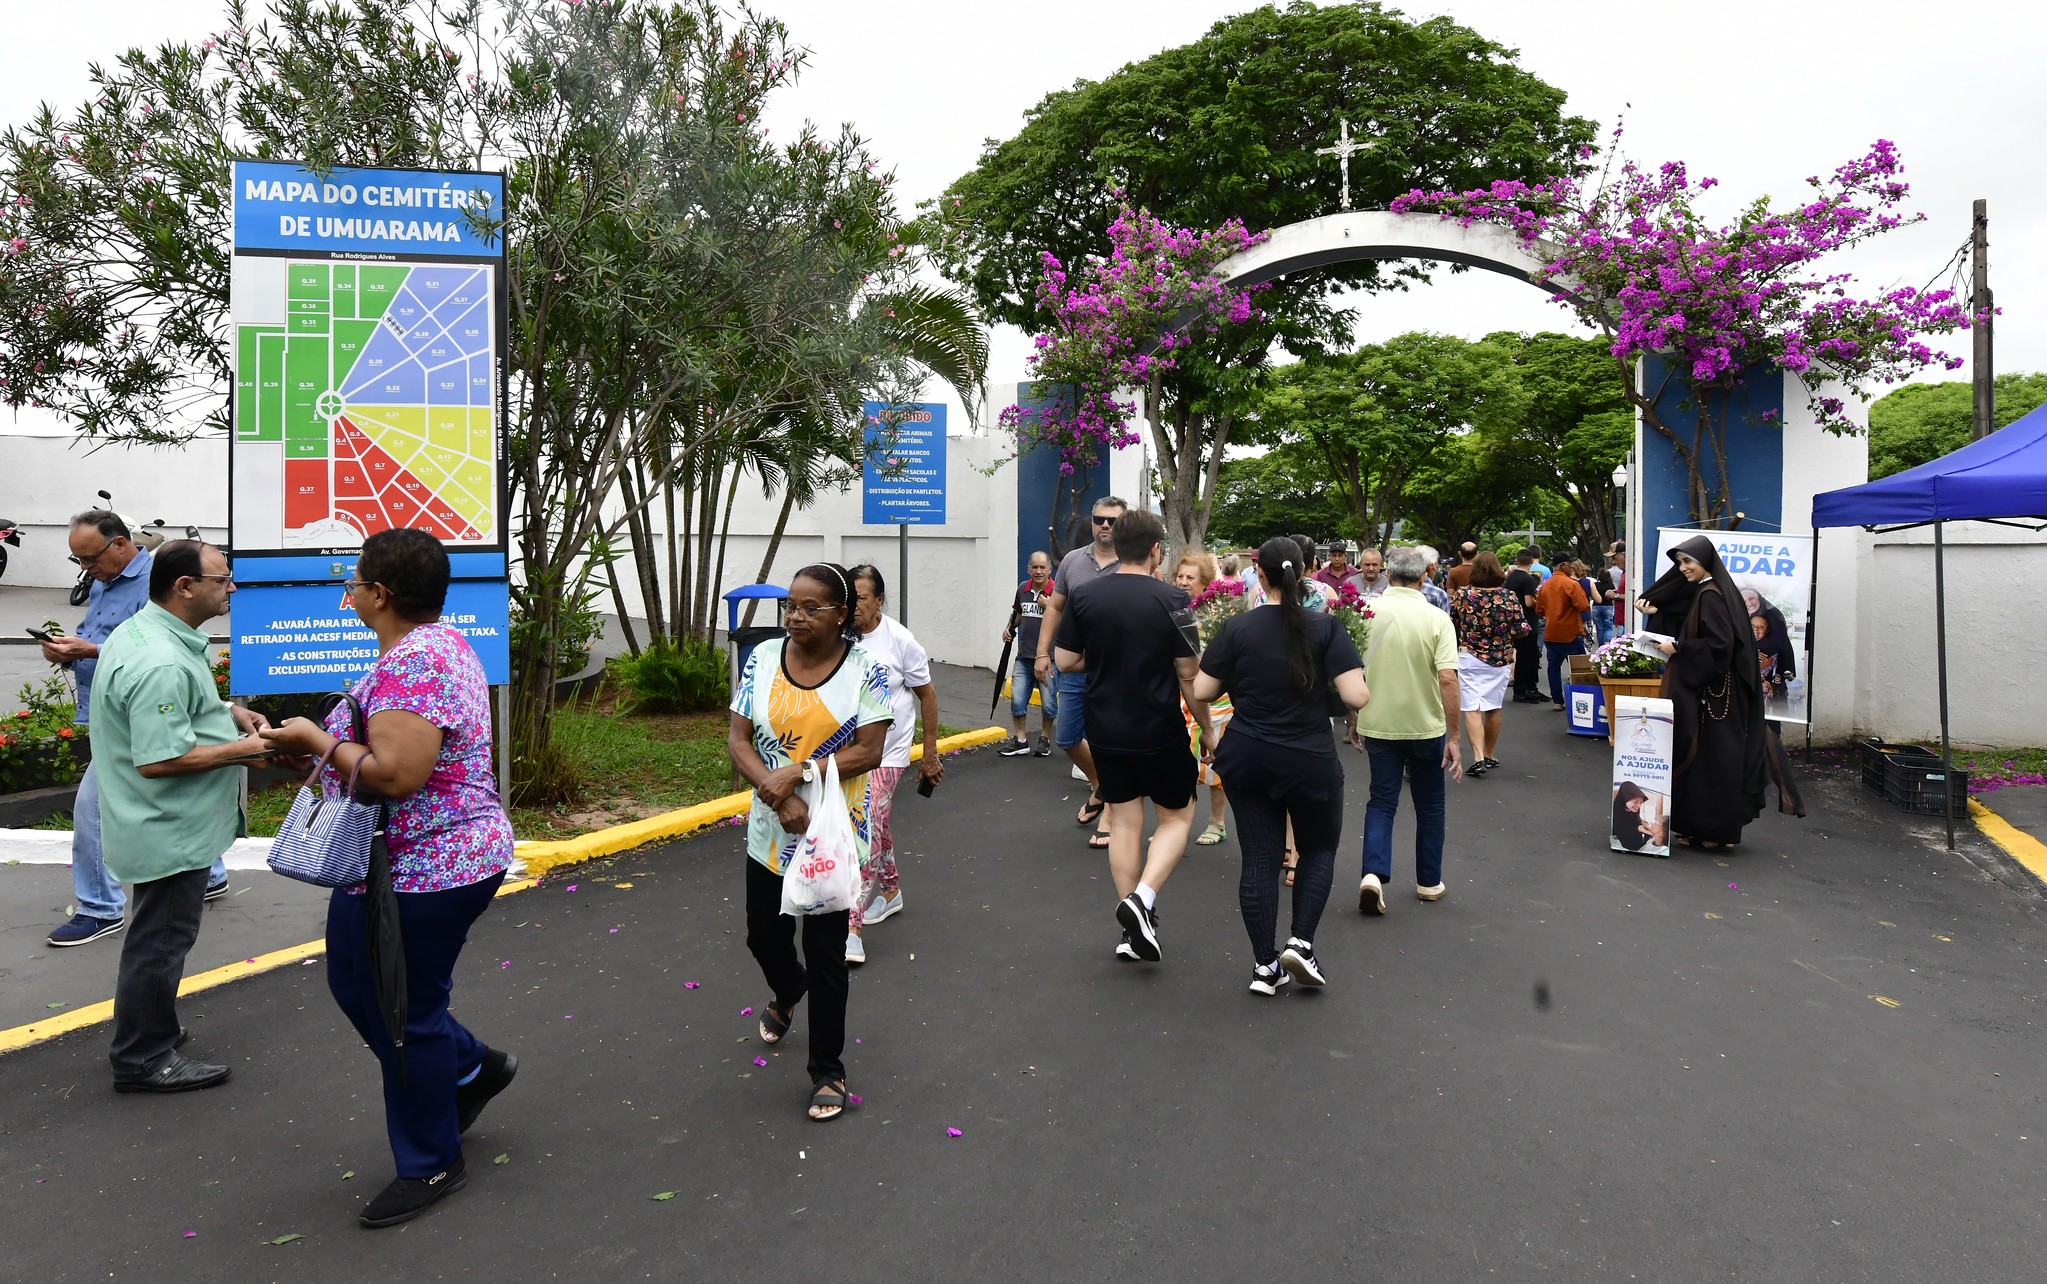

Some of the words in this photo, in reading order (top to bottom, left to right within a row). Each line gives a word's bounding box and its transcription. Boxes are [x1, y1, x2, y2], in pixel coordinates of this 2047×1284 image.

[245, 179, 319, 203] MAPA
[324, 184, 357, 204] DO
[363, 182, 492, 210] CEMITÉRIO
[280, 216, 311, 236] DE
[317, 217, 461, 242] UMUARAMA
[345, 252, 377, 261] Rodrigues
[1718, 544, 1773, 555] AJUDE
[1777, 547, 1790, 556] A
[272, 617, 311, 630] ALVARÁ
[313, 619, 340, 628] PARA
[458, 615, 476, 623] SER
[241, 634, 293, 644] RETIRADO
[294, 633, 309, 642] NA
[310, 633, 341, 642] ACESF
[470, 628, 498, 636] TAXA.
[282, 652, 296, 660] AS
[298, 647, 369, 660] CONSTRUÇÕES
[268, 664, 346, 675] EXCLUSIVIDADE
[348, 663, 362, 672] DA
[1627, 761, 1669, 770] AJUDAR
